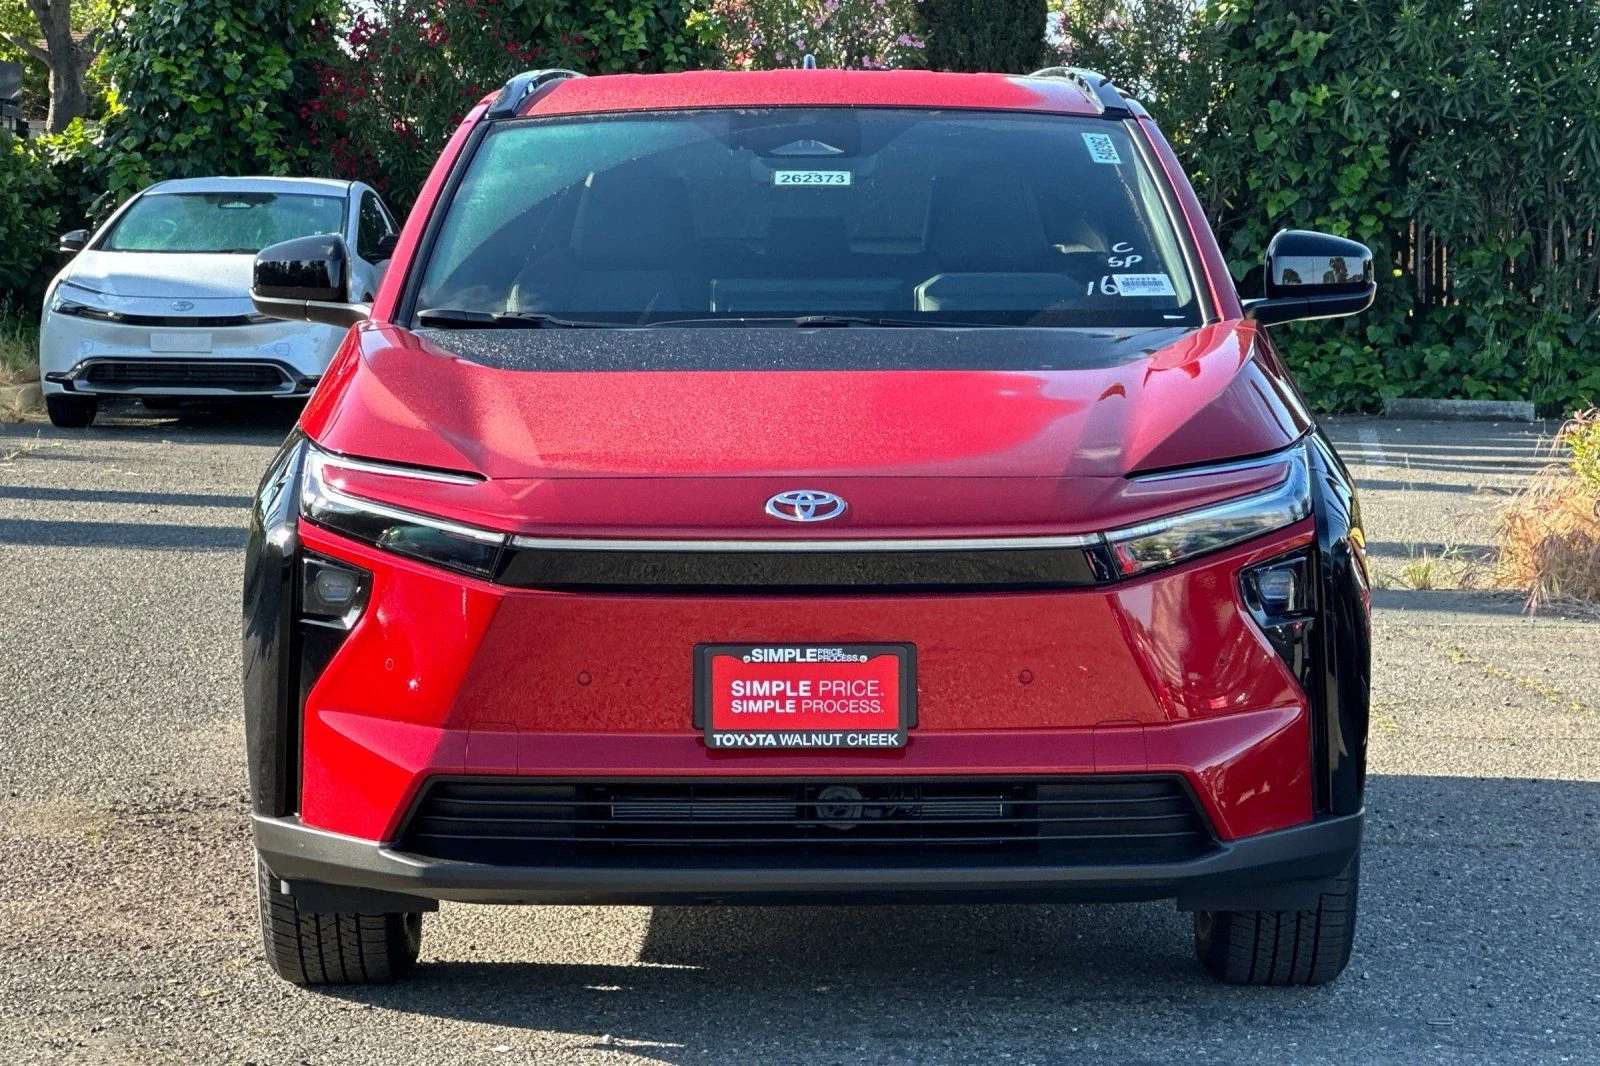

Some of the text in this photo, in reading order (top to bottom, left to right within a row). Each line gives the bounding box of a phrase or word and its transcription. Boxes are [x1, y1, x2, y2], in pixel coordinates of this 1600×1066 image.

[780, 174, 846, 184] 262373
[1112, 241, 1135, 253] C
[1108, 254, 1143, 268] SP
[751, 648, 817, 663] SIMPLE
[730, 680, 885, 697] SIMPLE PRICE.
[730, 699, 885, 714] SIMPLE PROCESS.
[712, 733, 899, 746] TOYOTA WALNUT CREEK
